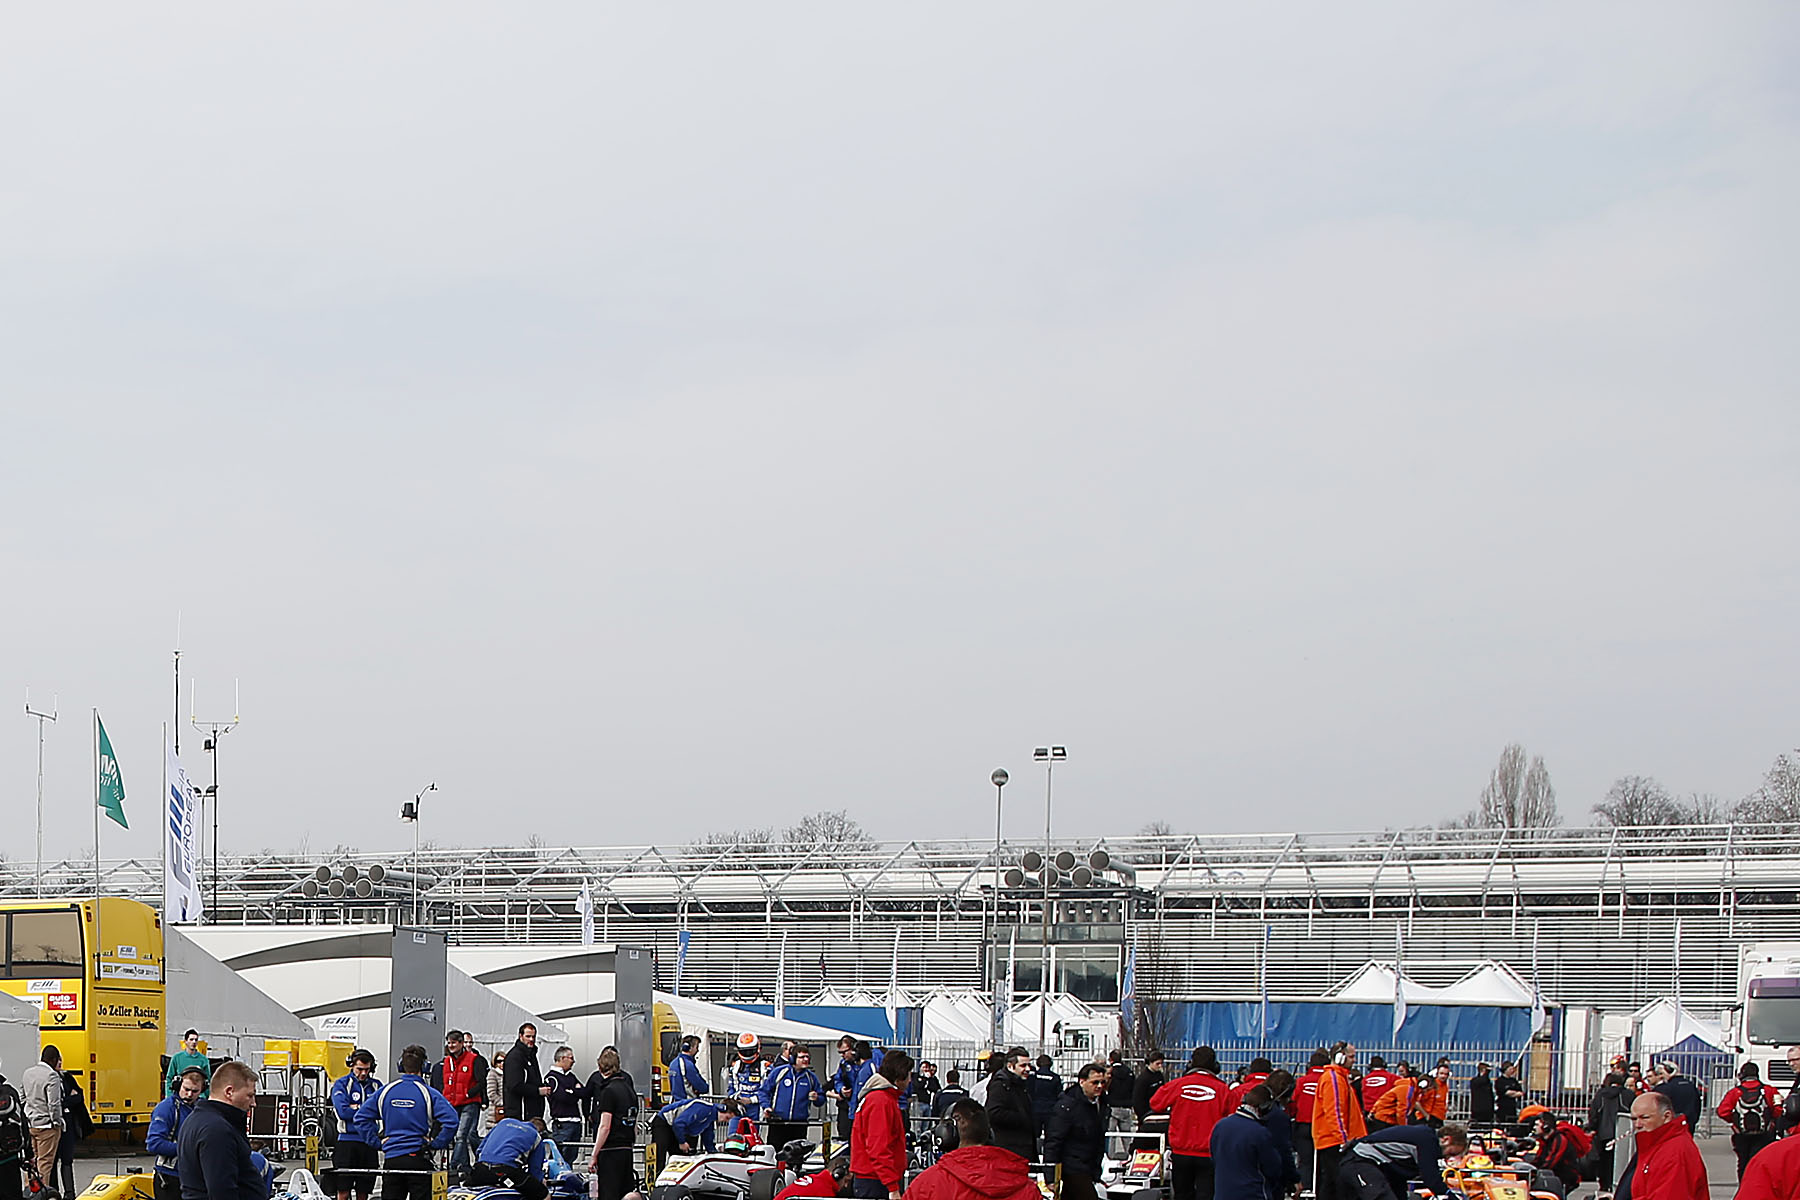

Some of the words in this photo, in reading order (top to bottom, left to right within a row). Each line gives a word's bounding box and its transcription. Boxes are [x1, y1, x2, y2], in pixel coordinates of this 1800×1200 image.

[49, 994, 71, 1002] auto
[98, 1004, 107, 1017] Jo
[108, 1004, 132, 1018] Zeller
[134, 1006, 160, 1021] Racing
[89, 1182, 109, 1192] 10
[1502, 1187, 1514, 1197] 5
